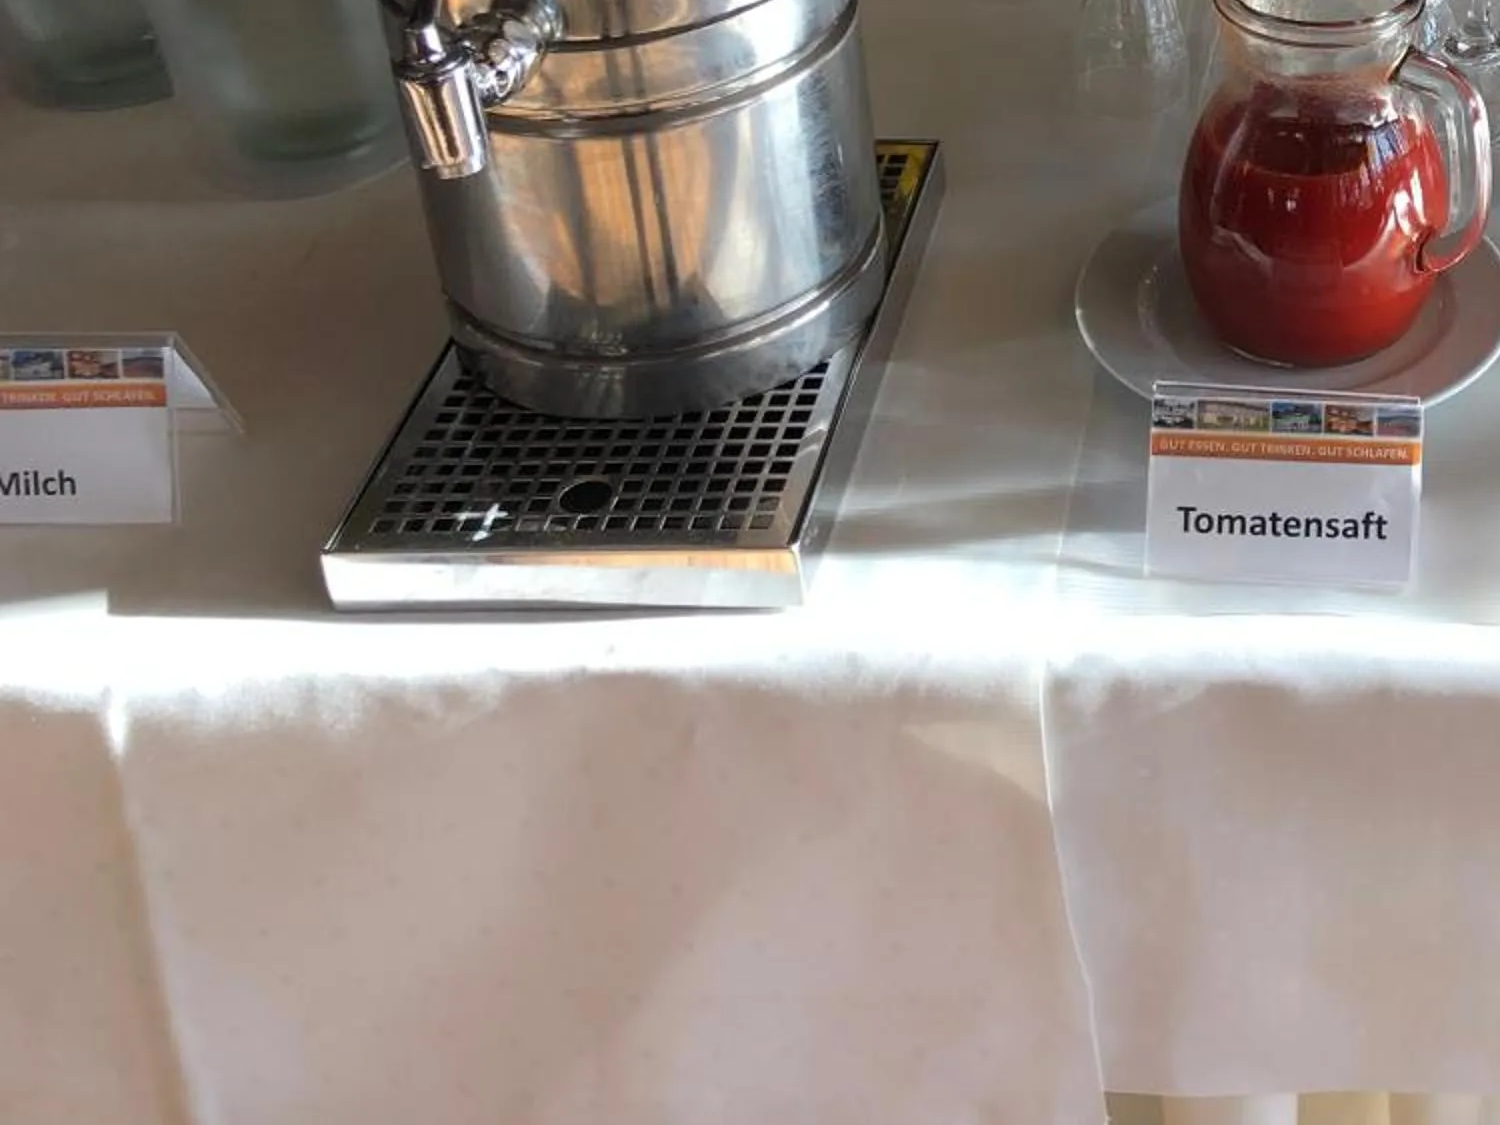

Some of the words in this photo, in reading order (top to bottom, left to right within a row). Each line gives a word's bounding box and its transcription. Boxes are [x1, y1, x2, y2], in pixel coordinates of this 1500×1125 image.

[1231, 442, 1257, 453] GUT
[1318, 445, 1343, 457] GUT
[1177, 506, 1389, 541] Tomatensaft
